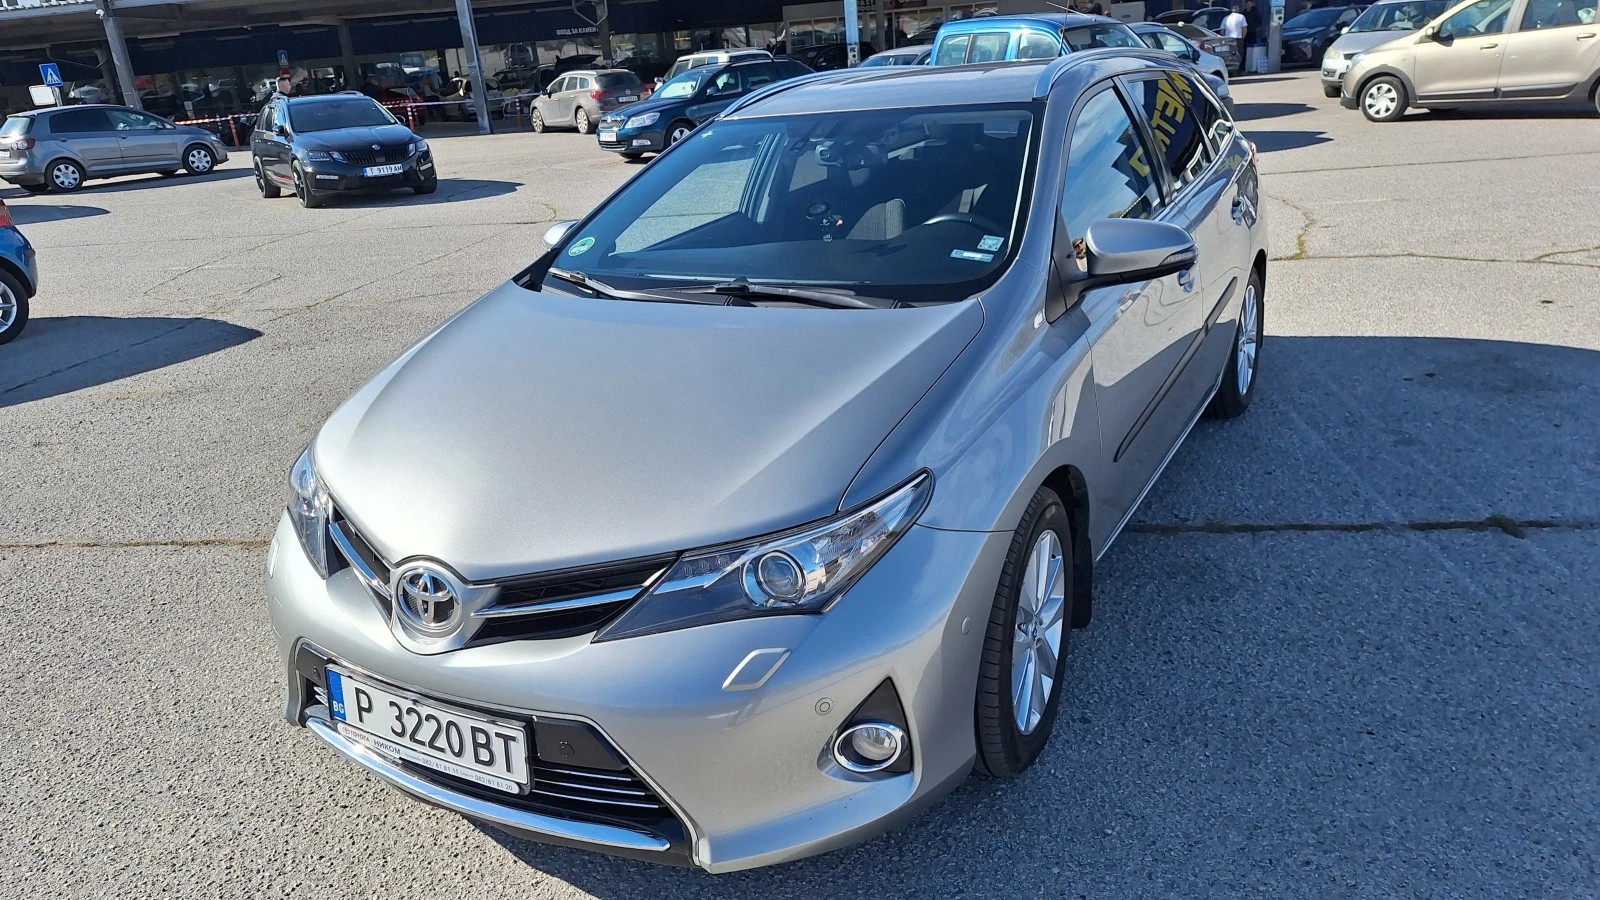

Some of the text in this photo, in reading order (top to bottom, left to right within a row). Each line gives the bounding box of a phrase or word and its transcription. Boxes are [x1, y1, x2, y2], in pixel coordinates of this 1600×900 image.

[332, 700, 345, 714] BG
[354, 686, 373, 723] P
[350, 730, 371, 743] TOYOTA
[373, 739, 401, 755] НИКОМ
